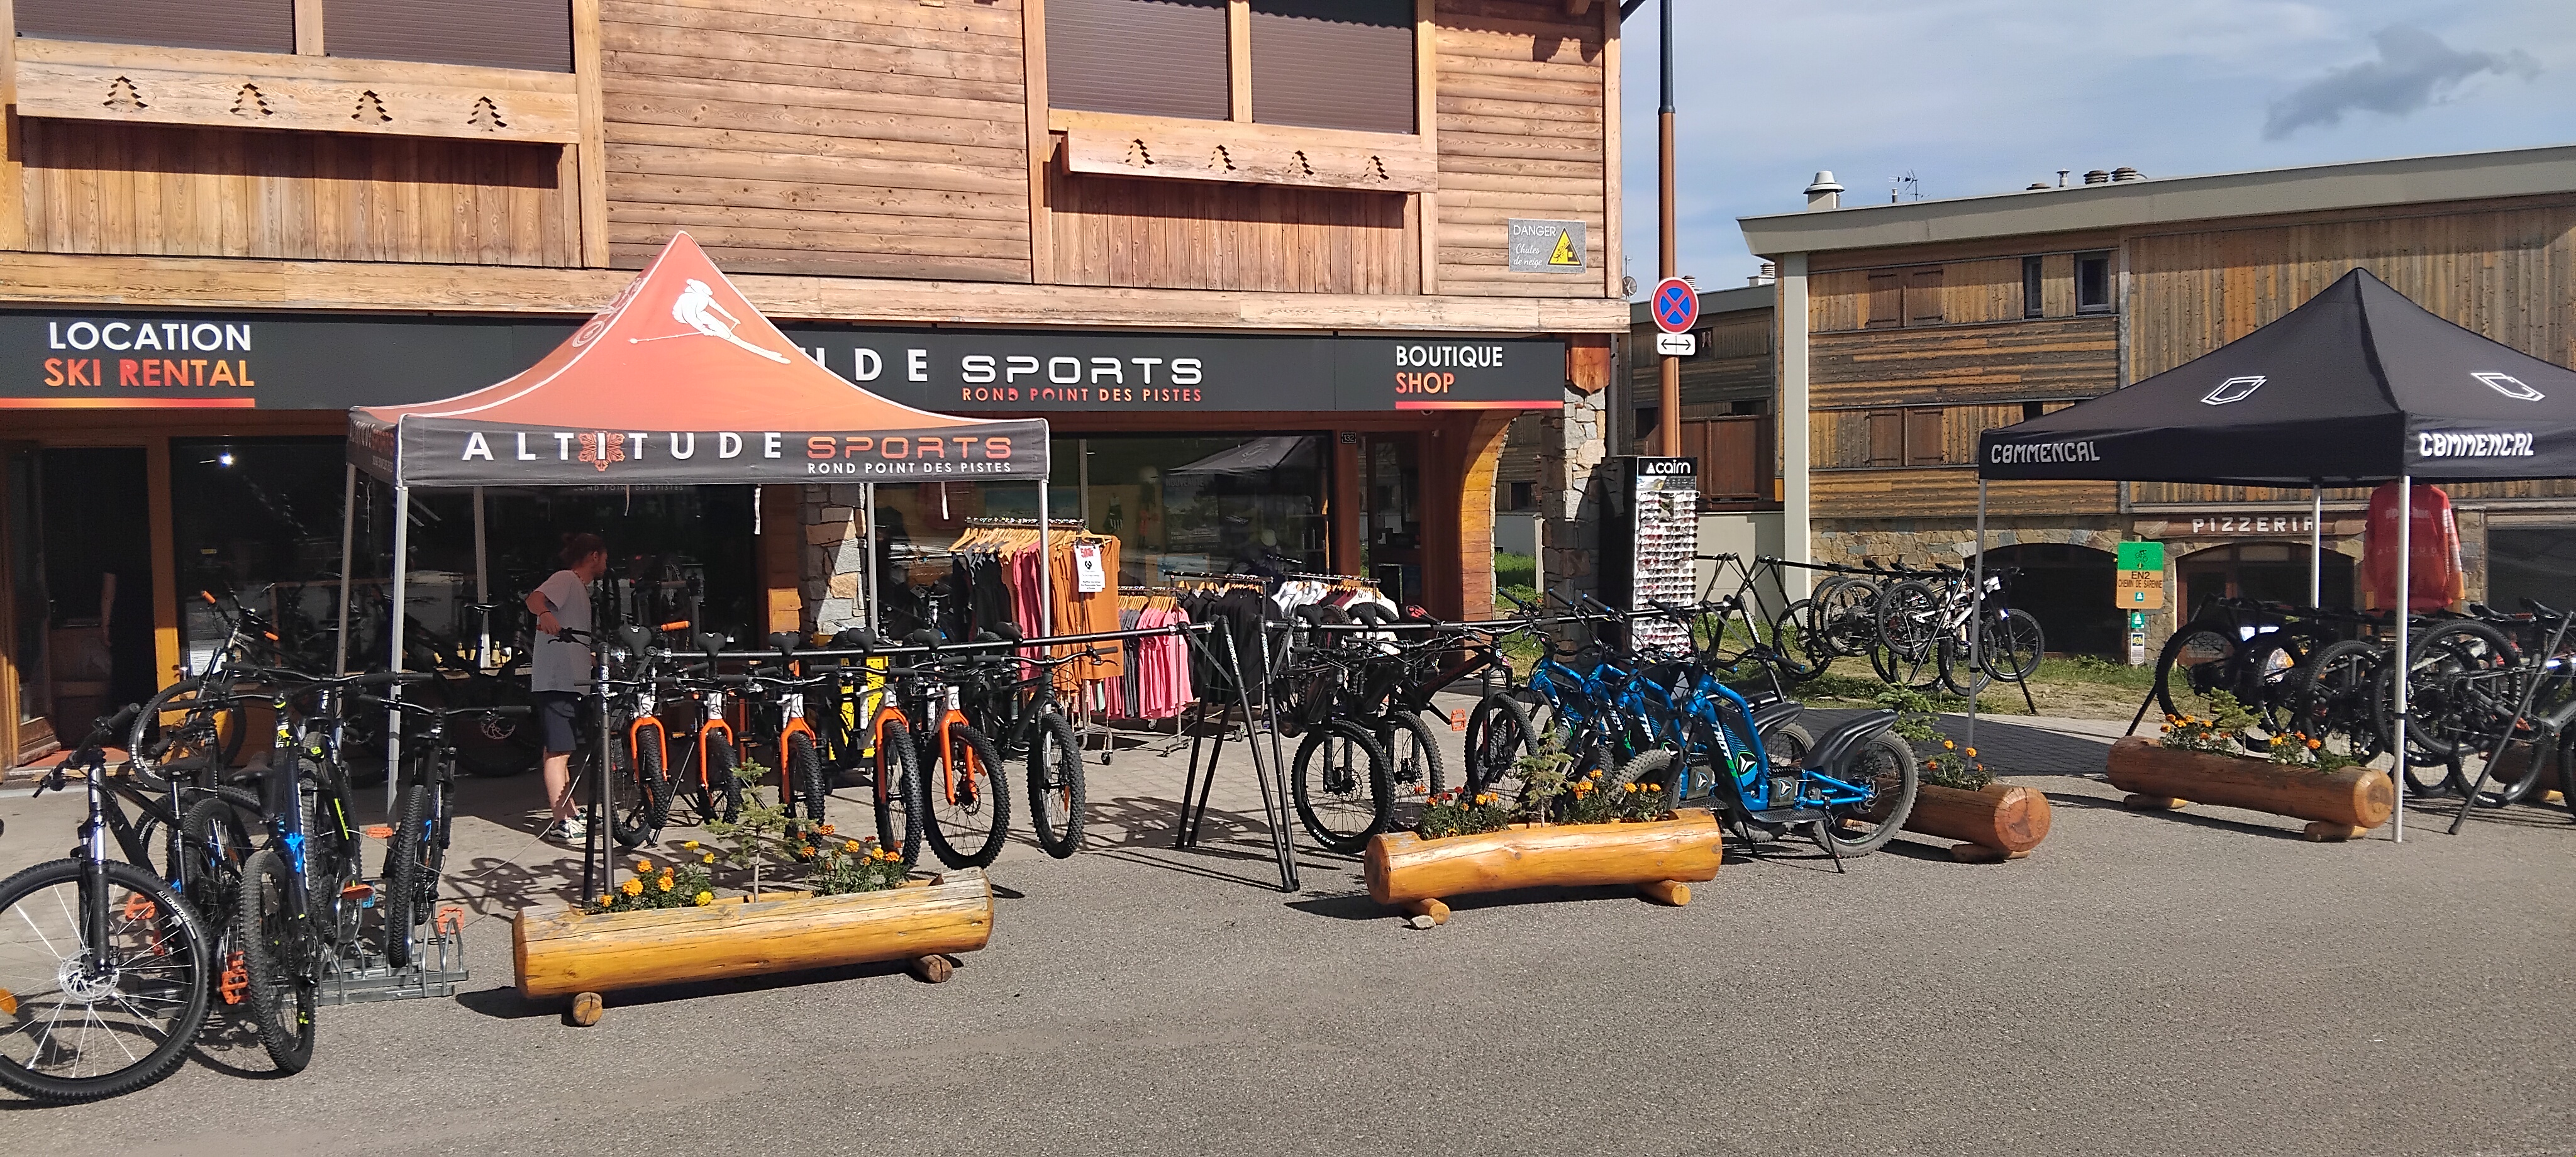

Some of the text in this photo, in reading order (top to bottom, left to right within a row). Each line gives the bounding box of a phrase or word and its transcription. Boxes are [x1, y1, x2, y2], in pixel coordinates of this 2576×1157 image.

[1513, 224, 1556, 236] DANGER
[1516, 243, 1540, 254] Chutes
[1513, 255, 1543, 268] de neige
[50, 321, 251, 351] LOCATION
[1396, 346, 1502, 368] BOUTIQUE
[44, 358, 255, 387] SKI RENTAL
[962, 355, 1202, 385] SPORTS
[1396, 372, 1455, 394] SHOP
[962, 387, 1202, 402] ROND POINT DES PISTES
[462, 432, 1011, 460] ALTITUDE SPORTS
[1991, 441, 2100, 463] COMMENCAL
[2419, 433, 2534, 457] COMMENCAL
[808, 462, 1011, 473] ROND POINT DES PISTES
[1655, 459, 1690, 473] cairn
[2192, 516, 2313, 533] PIZZERIA
[2118, 579, 2134, 587] CHEMIN
[2131, 571, 2150, 579] EN2
